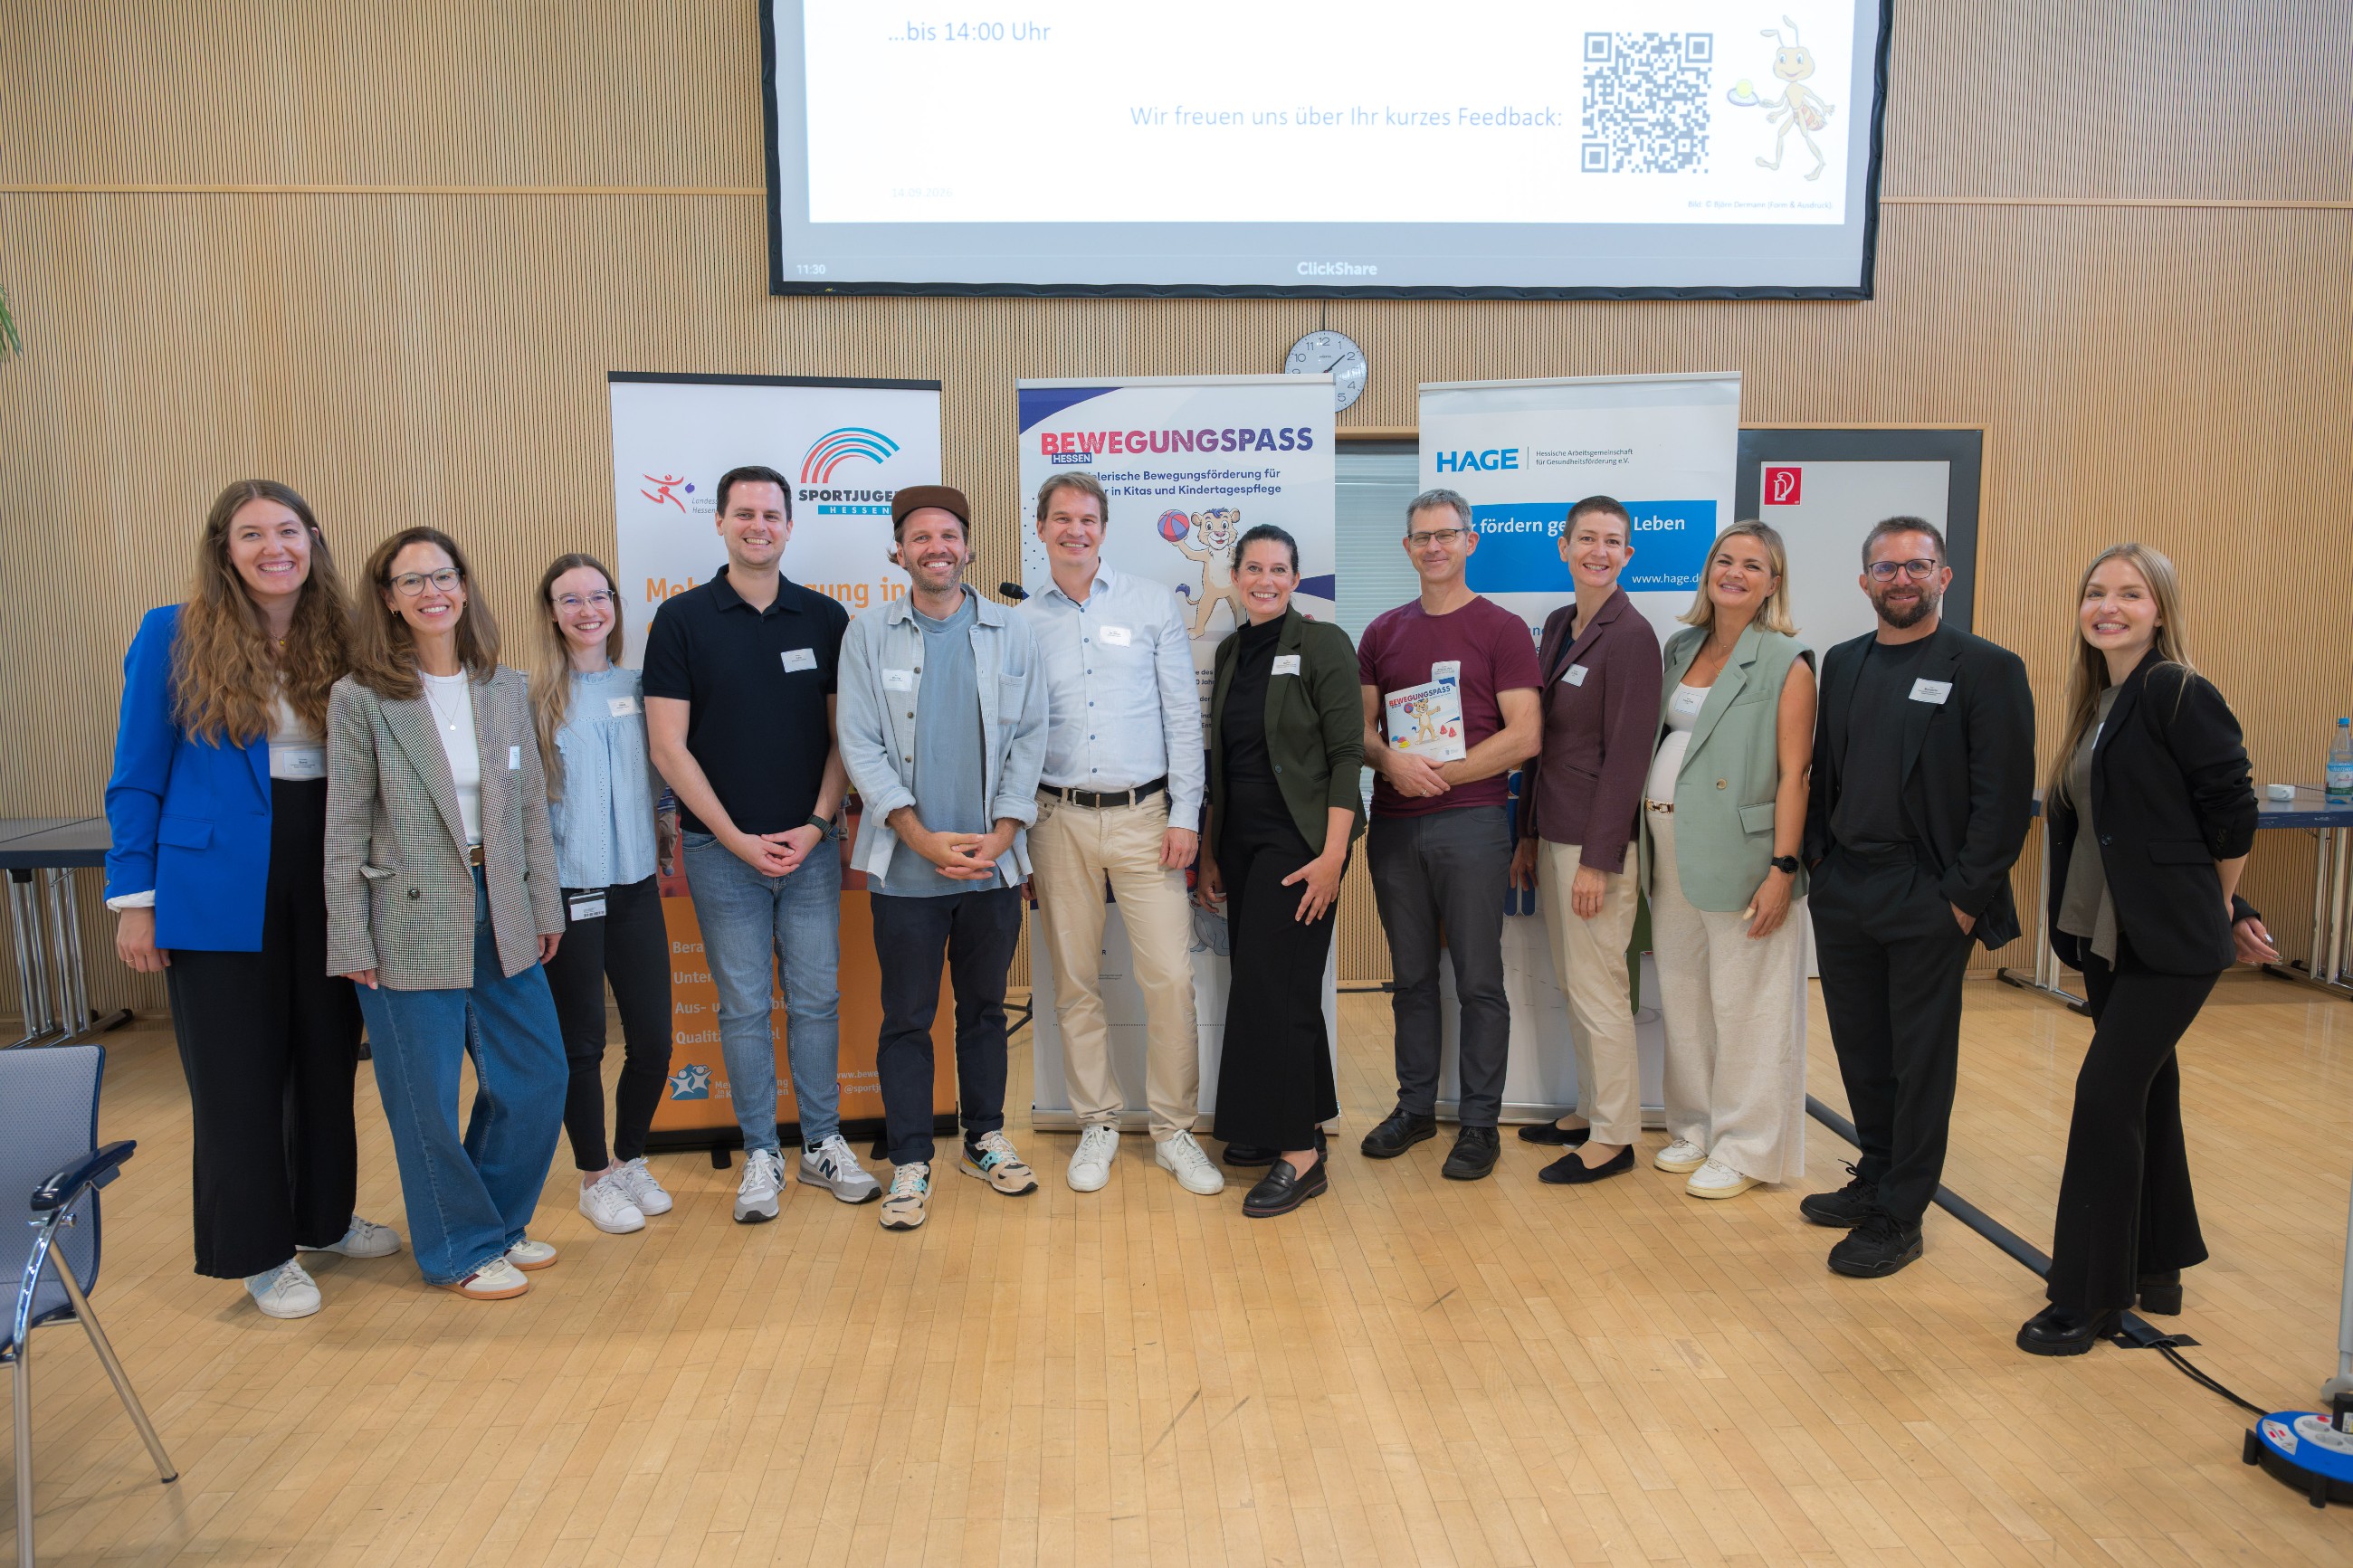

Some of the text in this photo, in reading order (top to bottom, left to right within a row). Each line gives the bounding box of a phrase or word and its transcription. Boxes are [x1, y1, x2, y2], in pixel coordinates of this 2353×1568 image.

[945, 21, 1005, 42] 14:00
[1012, 20, 1052, 42] Uhr
[1130, 105, 1563, 127] Wir freuen uns über Ihr kurzes Feedback:
[796, 263, 826, 275] 11:30
[1297, 261, 1378, 276] ClickShare
[1306, 341, 1314, 351] 11
[1319, 337, 1330, 347] 12
[1294, 353, 1307, 363] 10
[1347, 351, 1356, 361] 2
[1347, 381, 1356, 390] 4
[1337, 393, 1347, 403] 5
[1041, 427, 1314, 455] BEWEGUNGSPASS
[1053, 453, 1091, 463] HESSEN
[1567, 448, 1634, 457] Arbeitsgemeinschaft
[1436, 448, 1519, 472] HAGE
[1546, 457, 1617, 465] Gesundheitsförderung
[1143, 469, 1262, 482] Bewegungsförderung
[1264, 468, 1281, 479] für
[798, 489, 894, 502] SPORTJUGE
[1111, 486, 1121, 496] in
[1124, 486, 1152, 496] Kitas
[1155, 485, 1176, 496] und
[1178, 484, 1281, 497] Kindertagespflege
[830, 507, 890, 515] HESSEN
[1480, 517, 1543, 534] fördern
[1634, 515, 1685, 531] Leben
[880, 576, 906, 602] in
[1388, 685, 1451, 707] BEWEGUNGSPASS
[672, 941, 704, 954] Bera
[673, 971, 712, 984] Unter
[674, 1002, 707, 1014] Aus-
